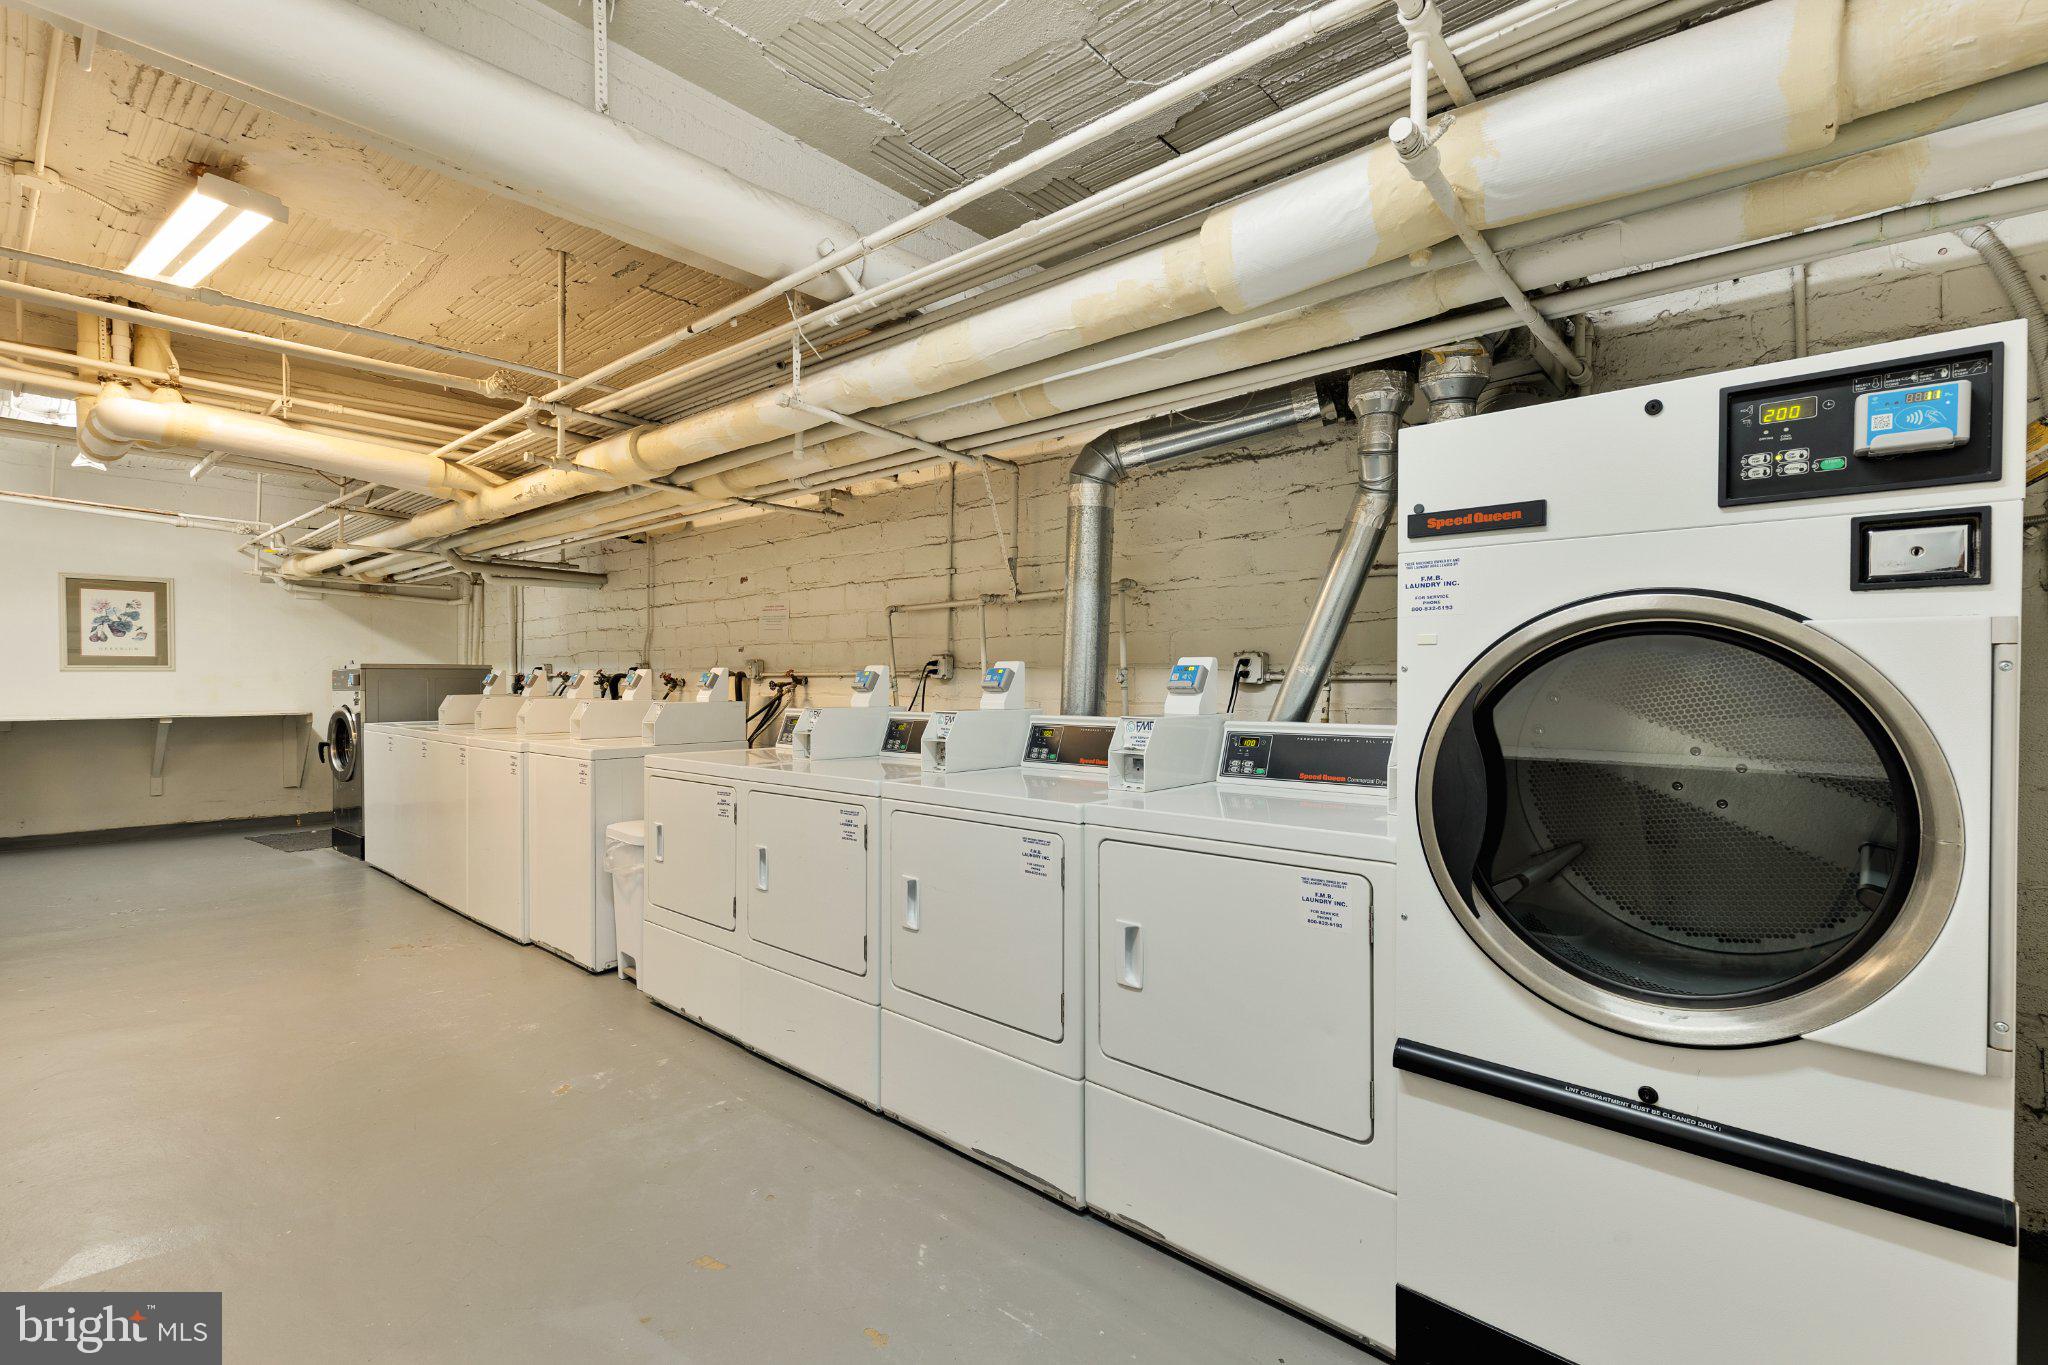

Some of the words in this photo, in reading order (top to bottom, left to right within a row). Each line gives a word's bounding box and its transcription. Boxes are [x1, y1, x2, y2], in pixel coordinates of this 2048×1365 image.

[1764, 405, 1801, 423] 200
[1427, 513, 1473, 530] Speed
[1473, 509, 1522, 523] Queen
[1405, 581, 1441, 590] LAUNDRY
[1299, 772, 1322, 781] Speed
[1322, 773, 1346, 782] Queen
[1302, 896, 1331, 905] LAUNDRY
[1565, 1086, 1579, 1094] LINT
[1580, 1089, 1629, 1108] COMPARTMENT
[1631, 1103, 1651, 1113] MUST
[1662, 1112, 1697, 1125] CLEANED
[1697, 1120, 1718, 1132] DAILY
